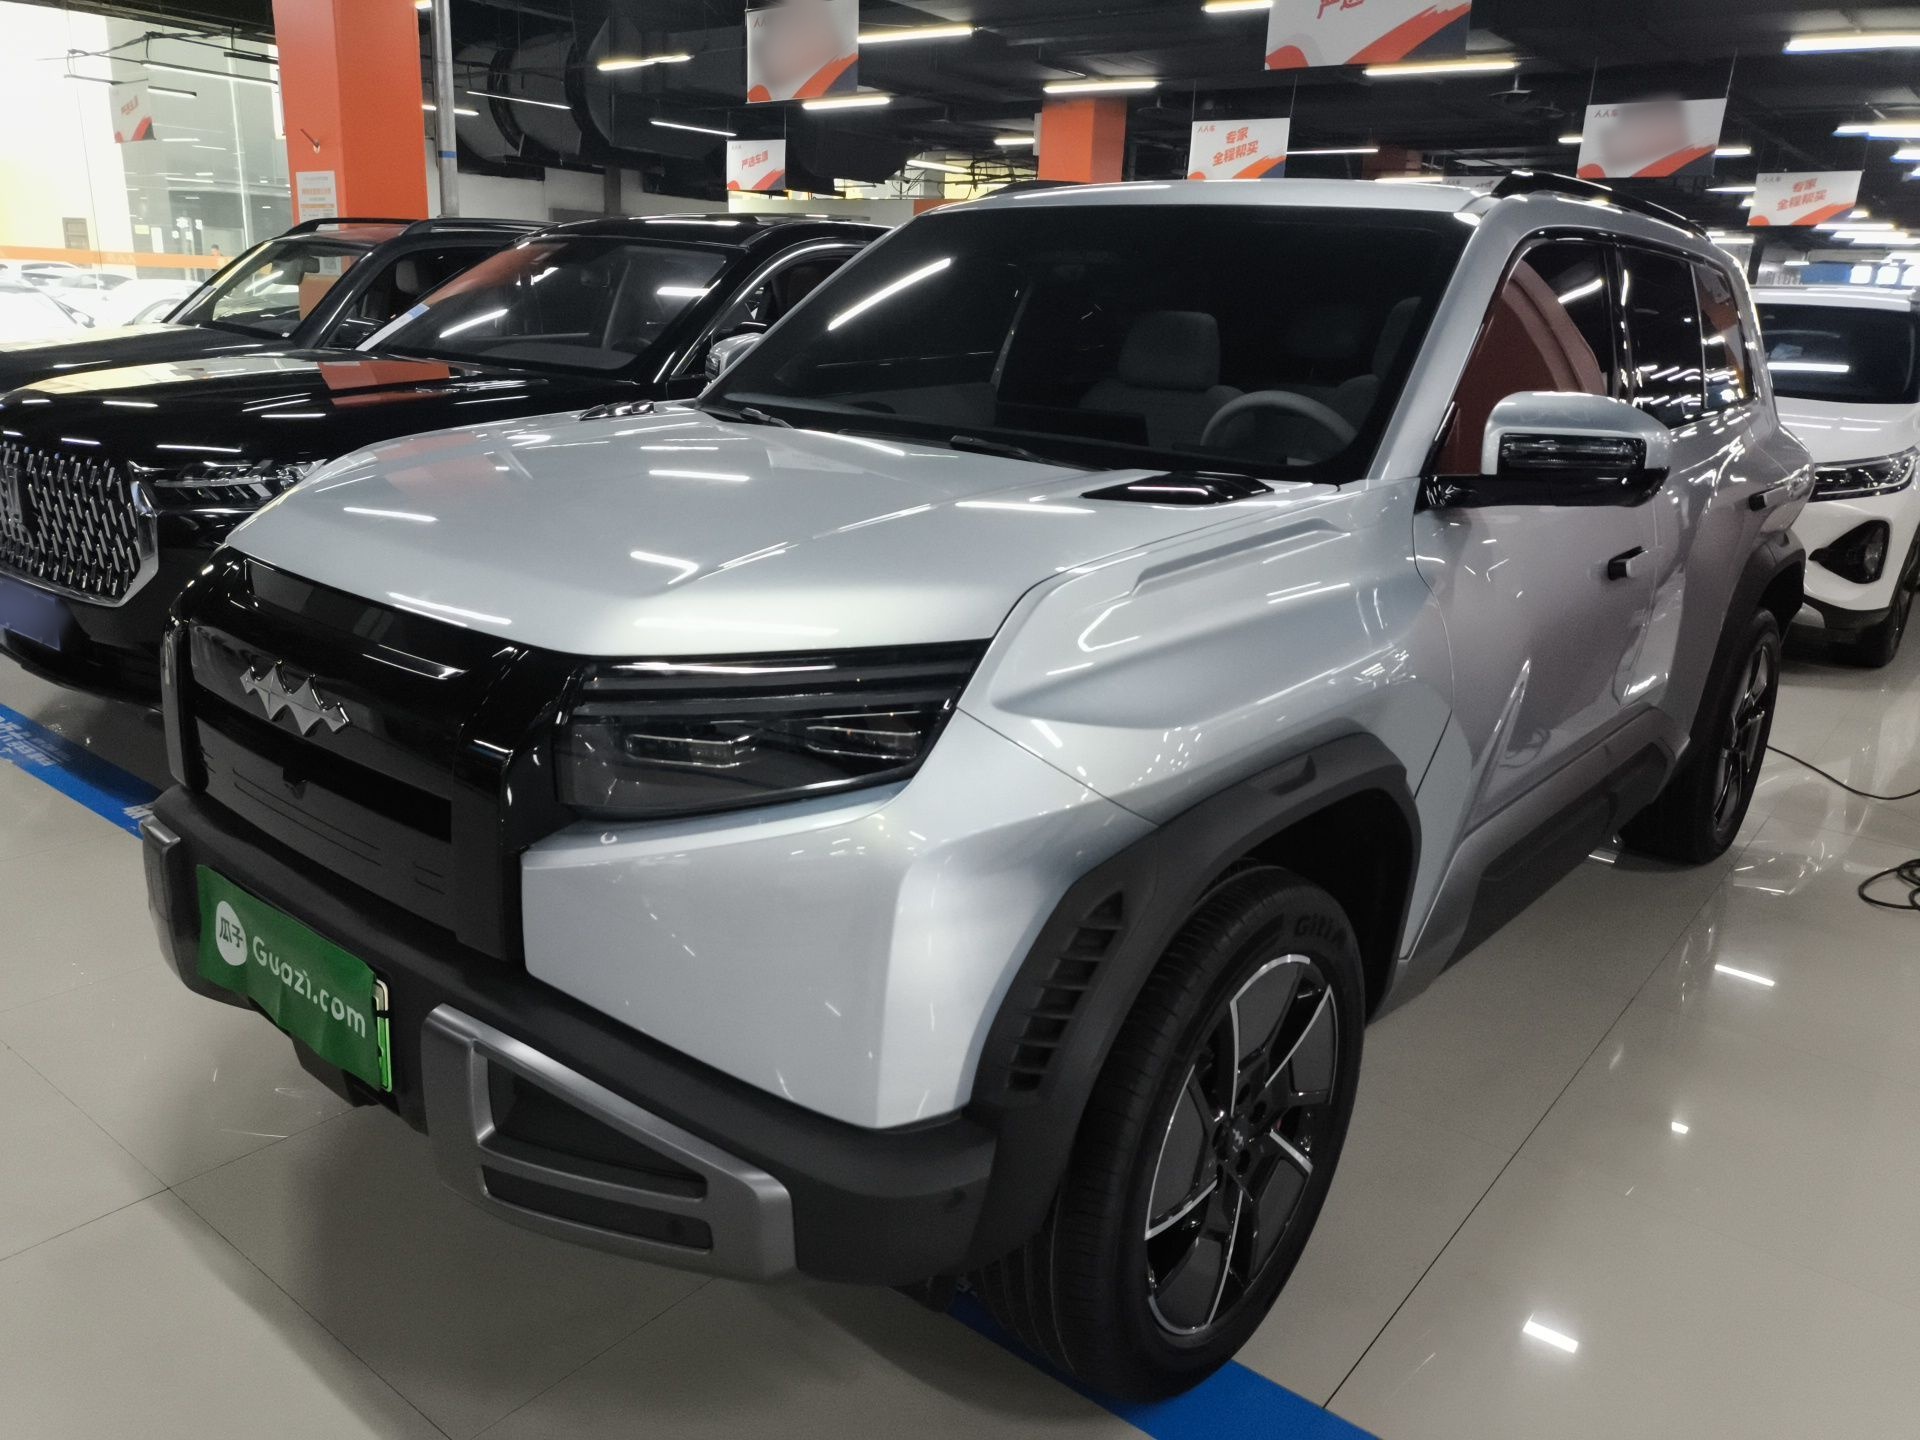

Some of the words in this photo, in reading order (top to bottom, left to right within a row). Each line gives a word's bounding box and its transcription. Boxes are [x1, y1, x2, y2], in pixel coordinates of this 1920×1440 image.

[1226, 127, 1249, 144] 专家
[1212, 140, 1259, 167] 全程帮买
[220, 917, 244, 948] 瓜子
[253, 936, 366, 1038] Guazi.com
